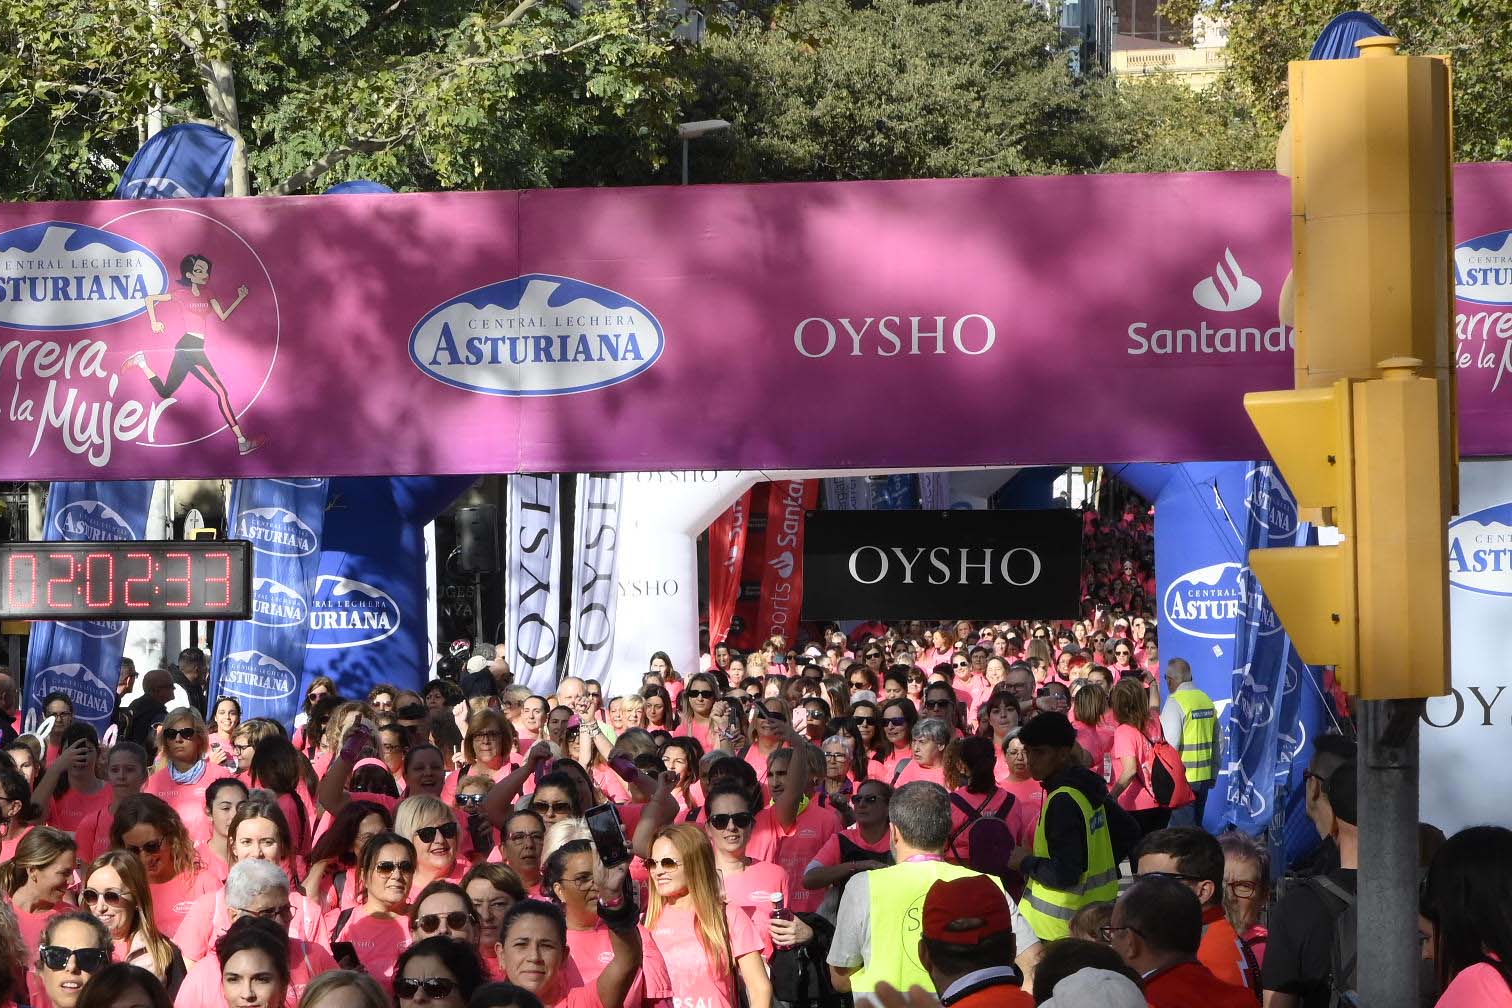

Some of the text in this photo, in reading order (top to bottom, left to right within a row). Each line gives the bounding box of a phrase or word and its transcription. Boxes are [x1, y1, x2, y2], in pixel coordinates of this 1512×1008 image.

[71, 257, 144, 269] LECHERA
[468, 315, 635, 330] CENTRAL LECHERA
[793, 313, 996, 358] OYSHO
[428, 321, 645, 366] ASTURIANA
[1477, 340, 1496, 369] la
[9, 381, 34, 422] la
[29, 374, 178, 467] Mujer
[236, 518, 310, 551] ASTURIANA
[848, 545, 1042, 586] OYSHO
[8, 552, 232, 609] 02:02:33
[618, 578, 679, 597] YSHO
[253, 599, 302, 621] URIANA
[337, 599, 387, 608] LECHERA
[1170, 591, 1239, 620] ASTUR
[310, 611, 392, 630] URIANA
